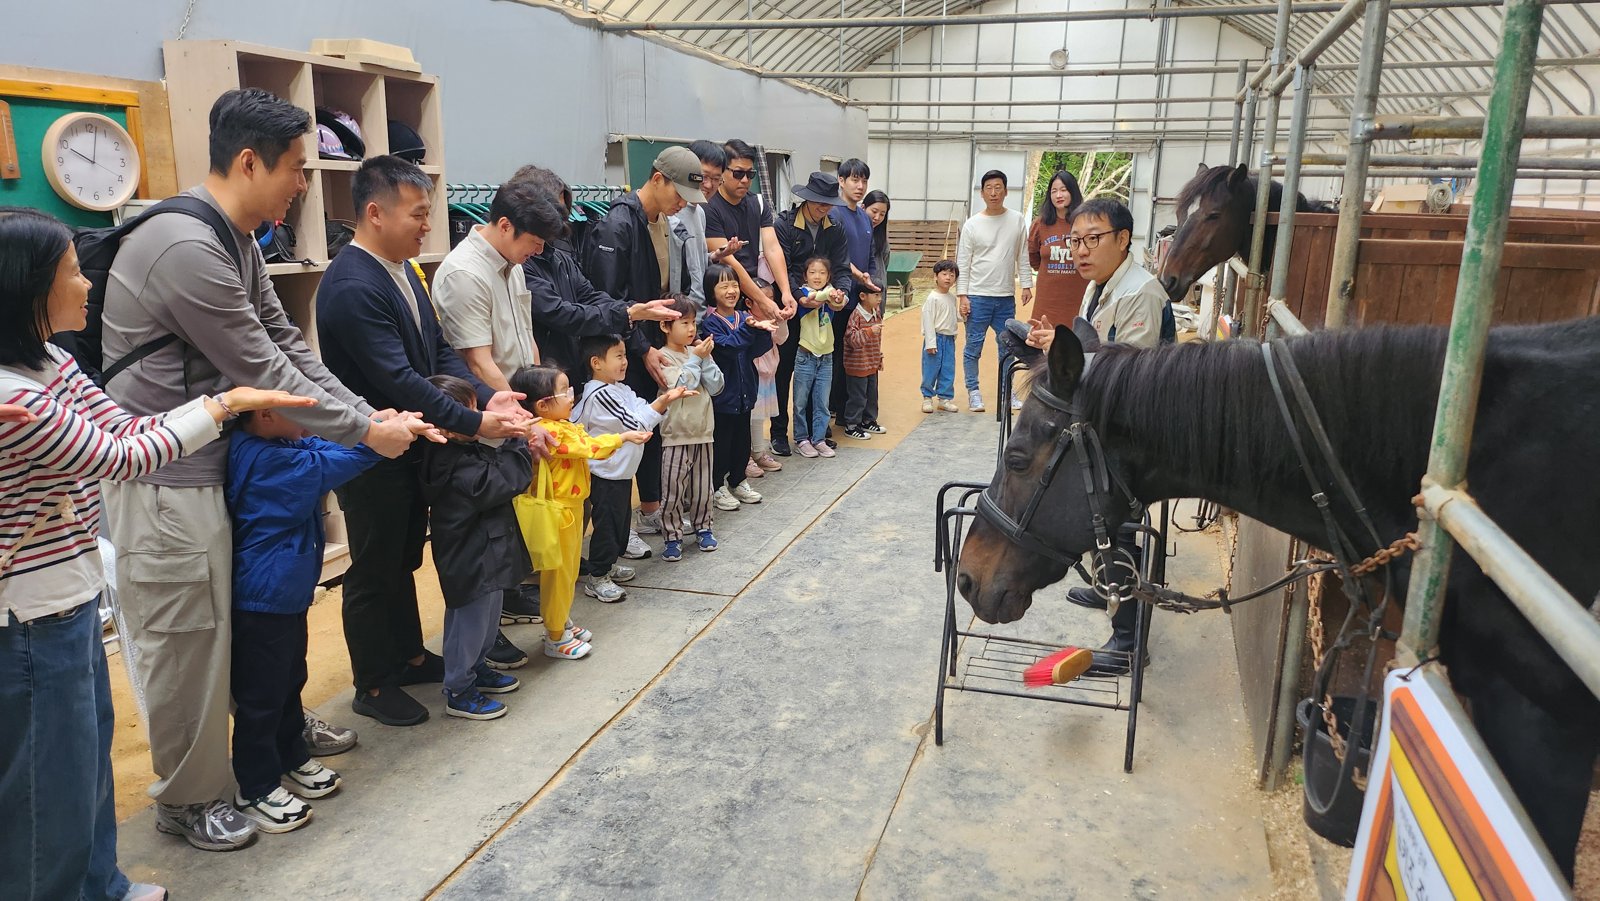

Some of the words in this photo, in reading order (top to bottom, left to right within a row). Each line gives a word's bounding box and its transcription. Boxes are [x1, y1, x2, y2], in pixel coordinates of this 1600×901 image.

[85, 123, 94, 134] 12
[60, 139, 69, 150] 10
[113, 141, 120, 151] 2
[57, 156, 64, 167] 9
[120, 158, 126, 168] 3
[64, 173, 71, 184] 8
[117, 174, 123, 183] 4
[77, 186, 83, 196] 7
[93, 191, 100, 201] 6
[108, 186, 114, 196] 5
